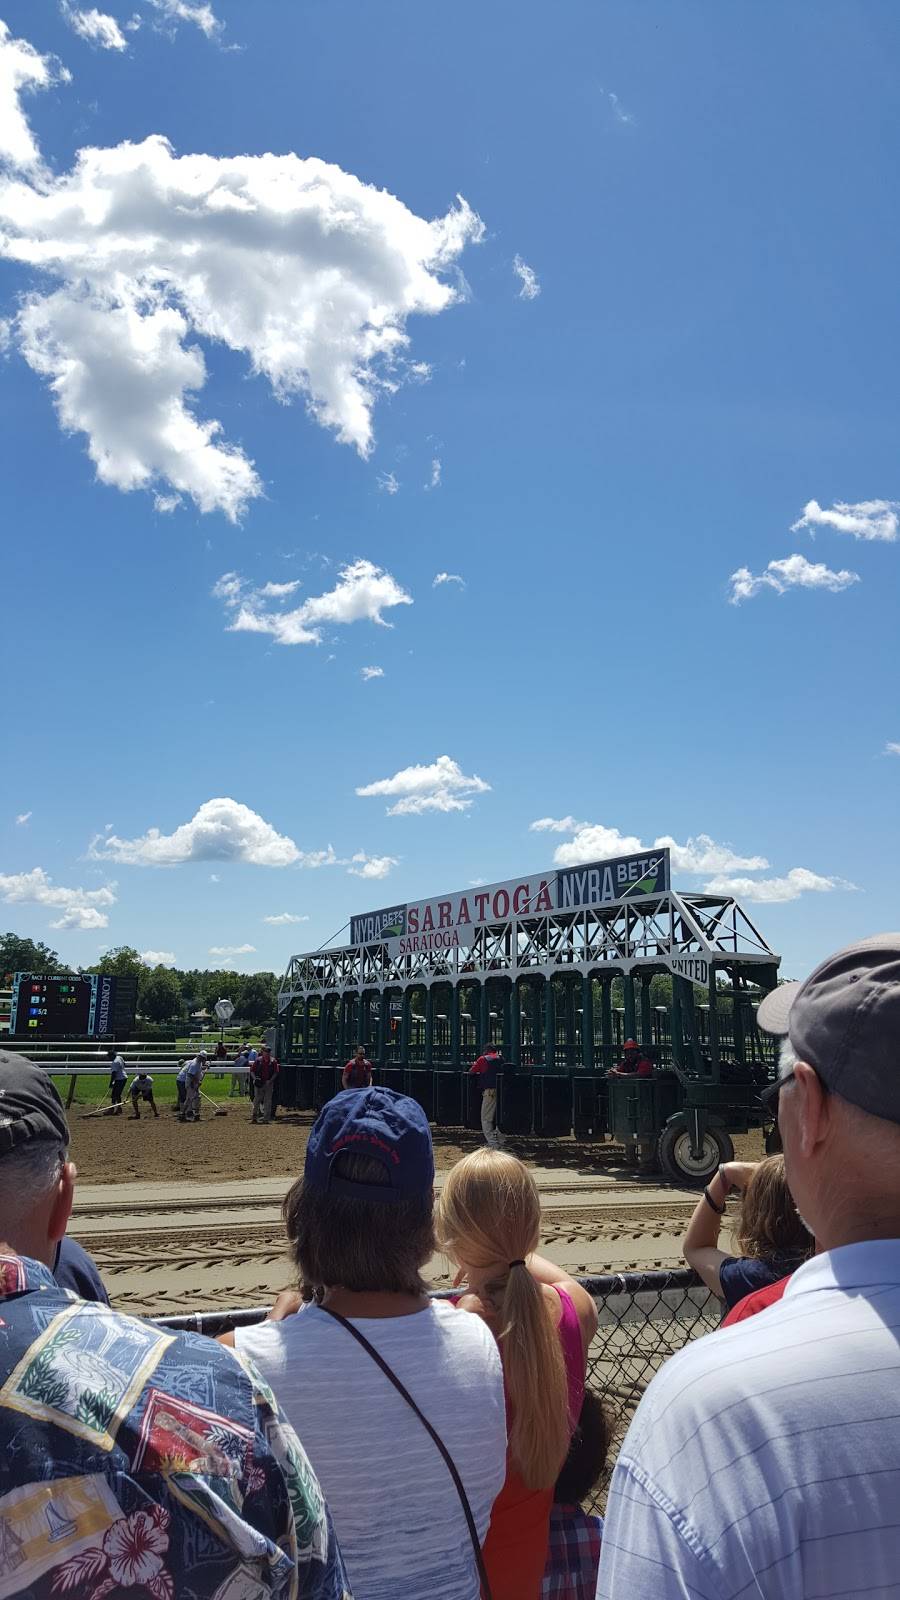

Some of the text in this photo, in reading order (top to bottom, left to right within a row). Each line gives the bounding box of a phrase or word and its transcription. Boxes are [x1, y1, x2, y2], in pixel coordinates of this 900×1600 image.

[562, 858, 659, 908] NYRA BETS
[407, 879, 554, 934] SARATOGA
[354, 911, 404, 944] NYRA BETS
[399, 926, 460, 954] SARATOGA
[672, 960, 707, 983] UNITED
[99, 977, 111, 1033] LONGINES
